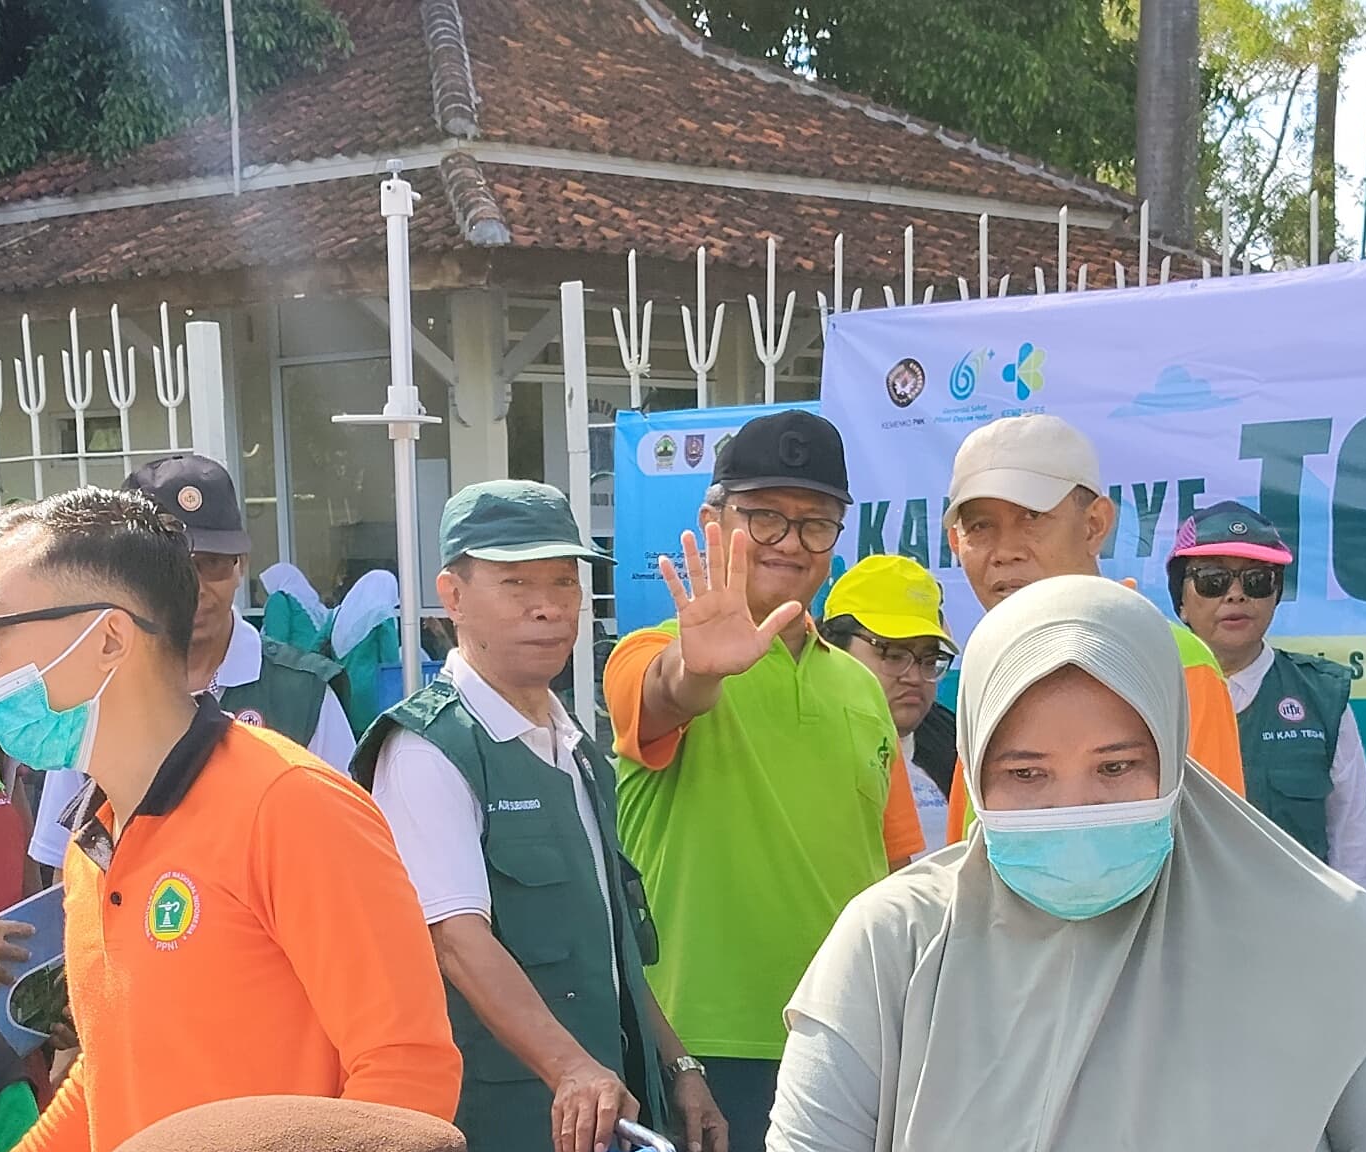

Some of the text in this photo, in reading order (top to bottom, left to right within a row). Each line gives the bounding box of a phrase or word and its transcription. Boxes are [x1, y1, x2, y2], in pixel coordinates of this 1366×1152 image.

[778, 430, 811, 467] G
[1277, 730, 1298, 740] KAB
[1300, 729, 1325, 740] TEGA
[156, 940, 179, 951] PPNI
